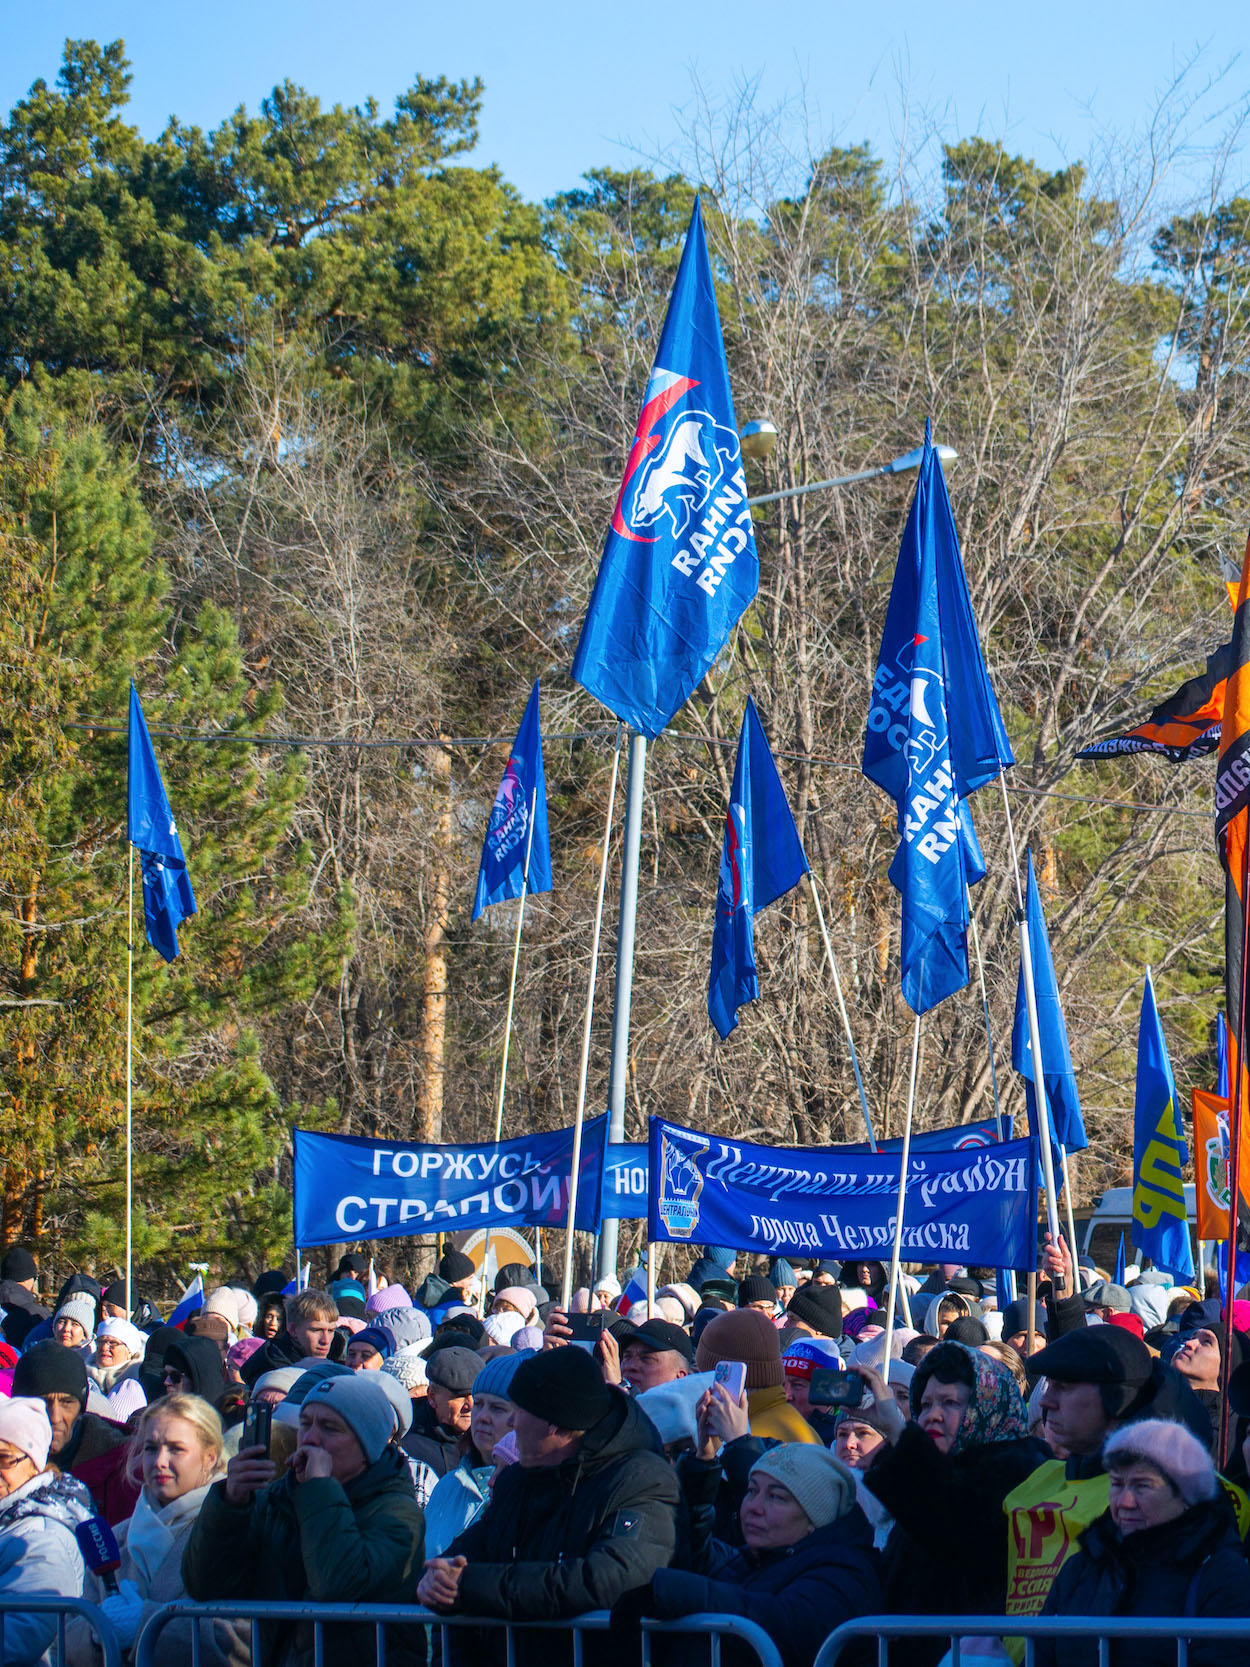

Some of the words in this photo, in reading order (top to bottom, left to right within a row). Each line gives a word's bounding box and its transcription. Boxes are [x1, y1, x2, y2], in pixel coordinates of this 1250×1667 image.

[373, 1149, 541, 1180] ГОРЖУСЬ
[921, 1154, 1028, 1208] район
[749, 1214, 822, 1251] города
